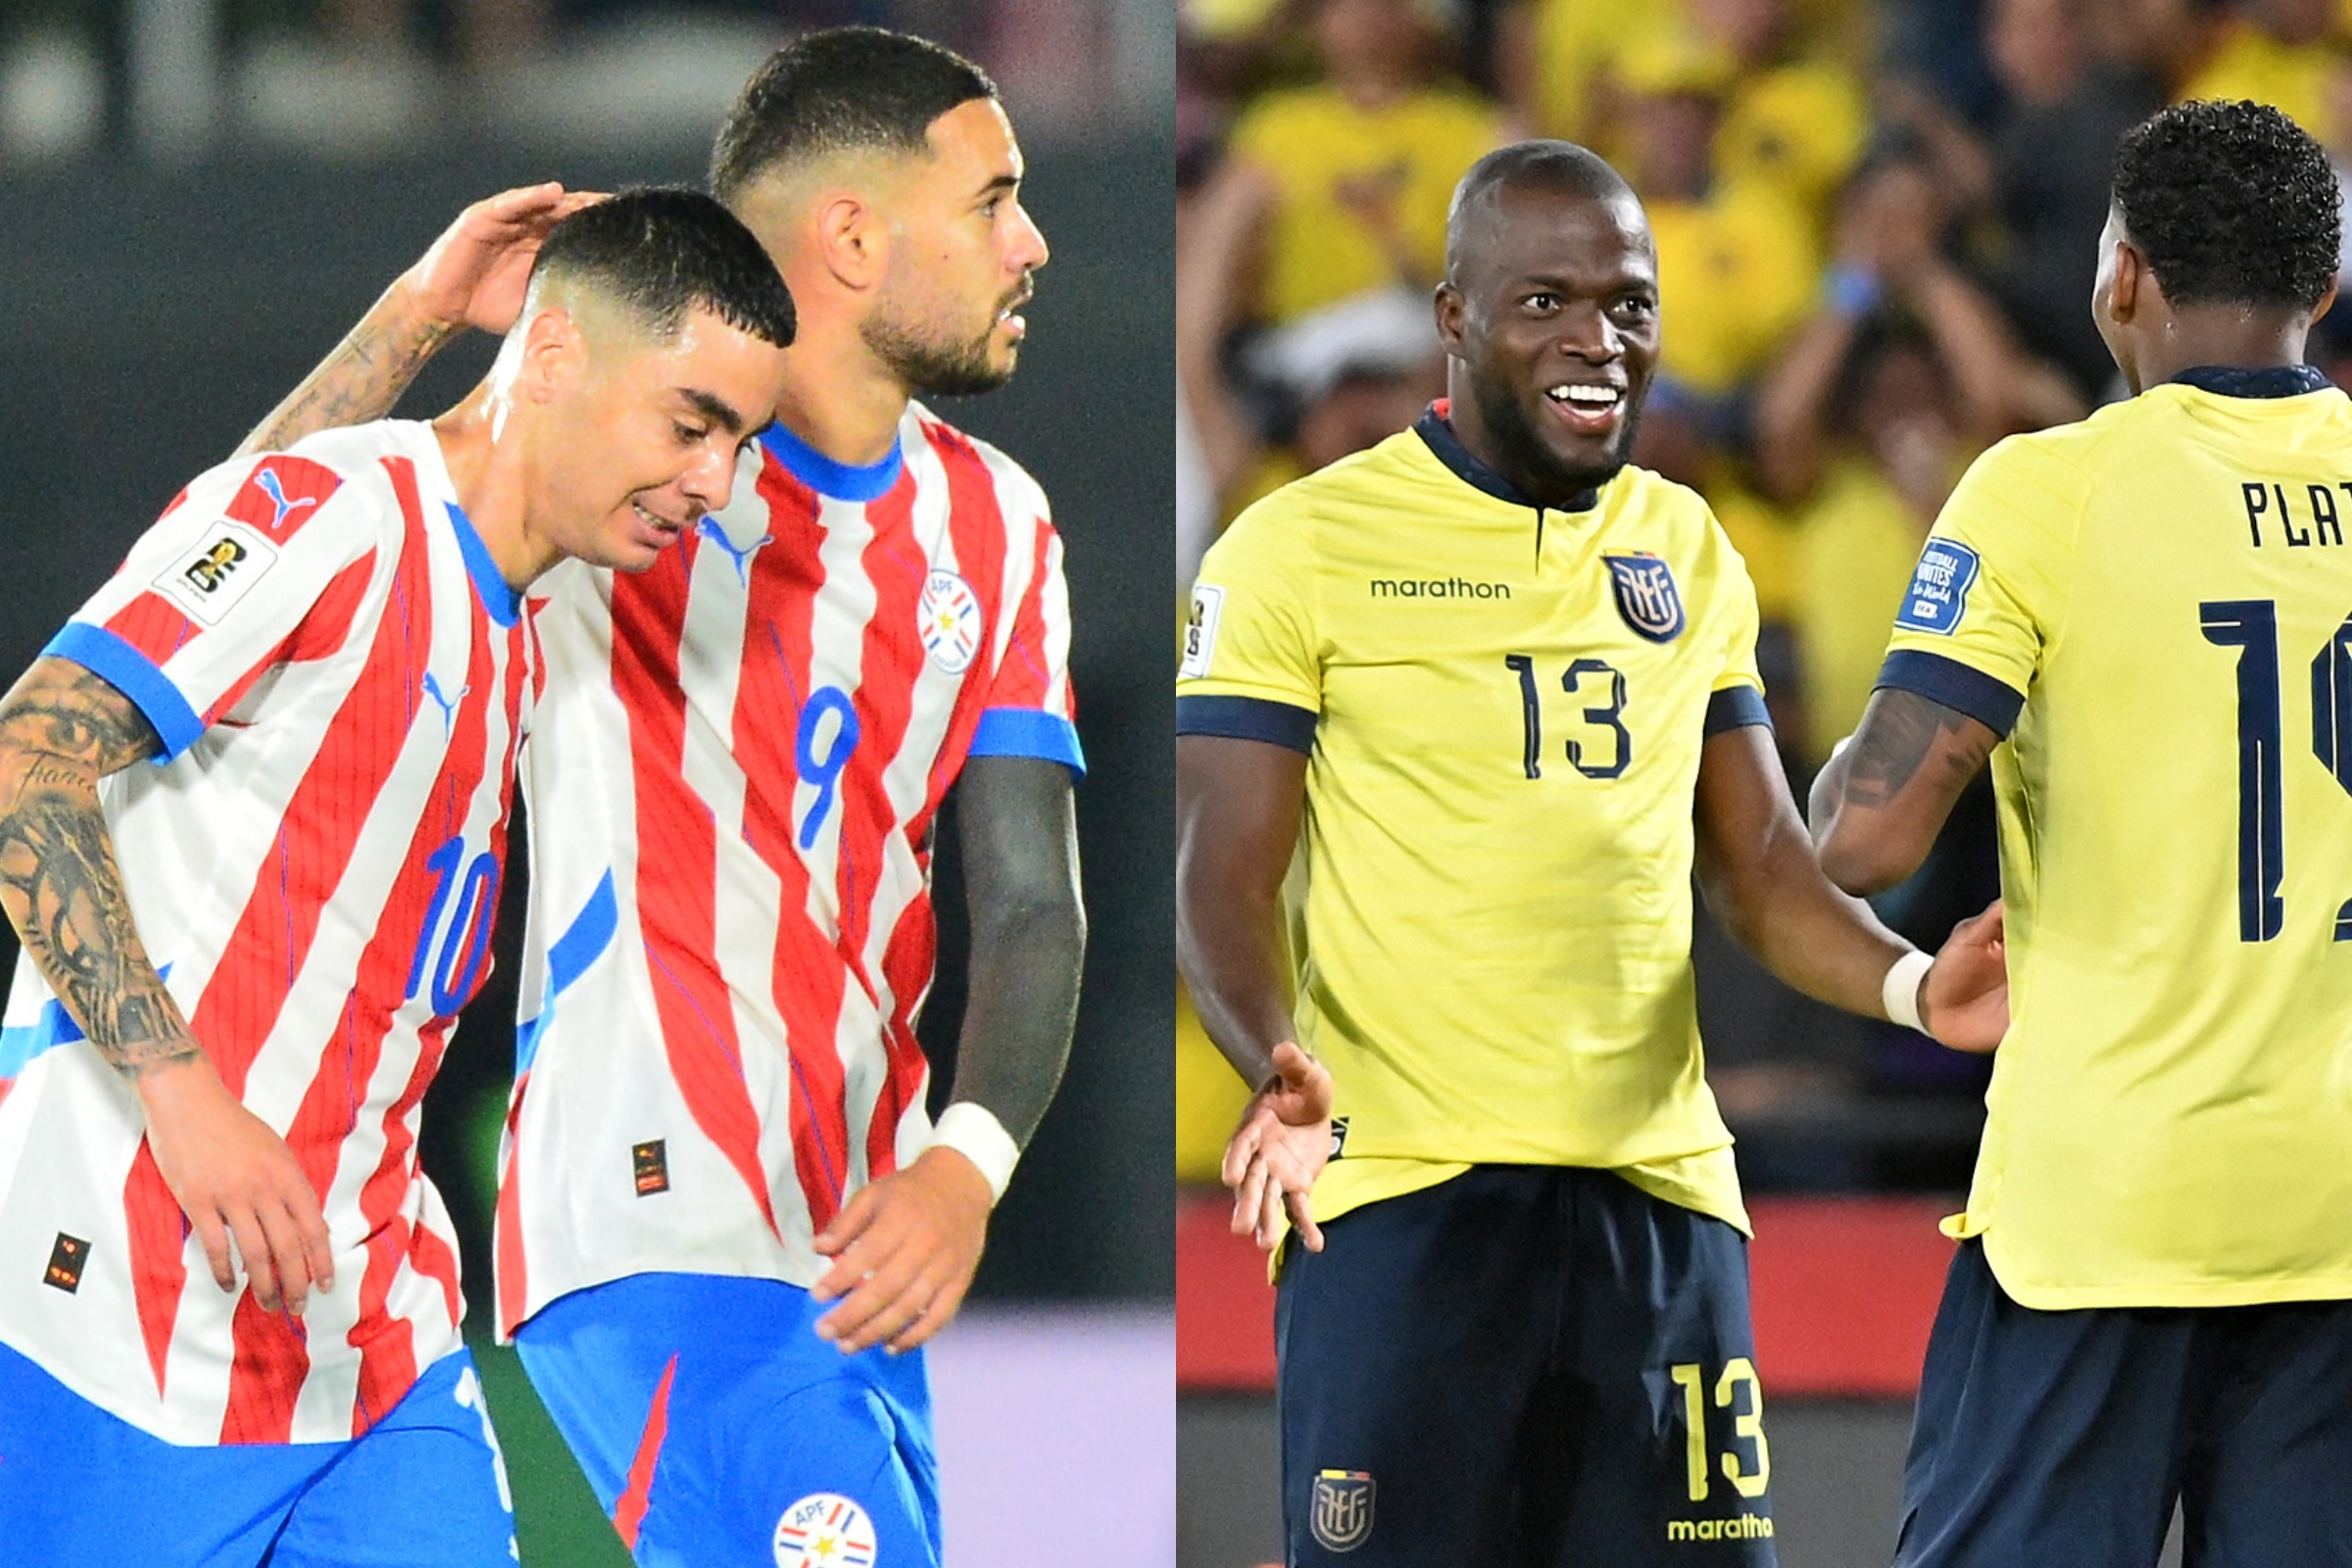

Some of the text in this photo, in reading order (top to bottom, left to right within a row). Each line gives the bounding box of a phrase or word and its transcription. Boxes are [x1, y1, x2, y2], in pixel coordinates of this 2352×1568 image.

[932, 579, 953, 594] APF
[1371, 577, 1511, 600] marathon
[795, 685, 861, 851] 9
[1505, 654, 1633, 780] 13
[405, 835, 499, 1017] 10
[1671, 1357, 1772, 1501] 13
[794, 1499, 826, 1527] APF
